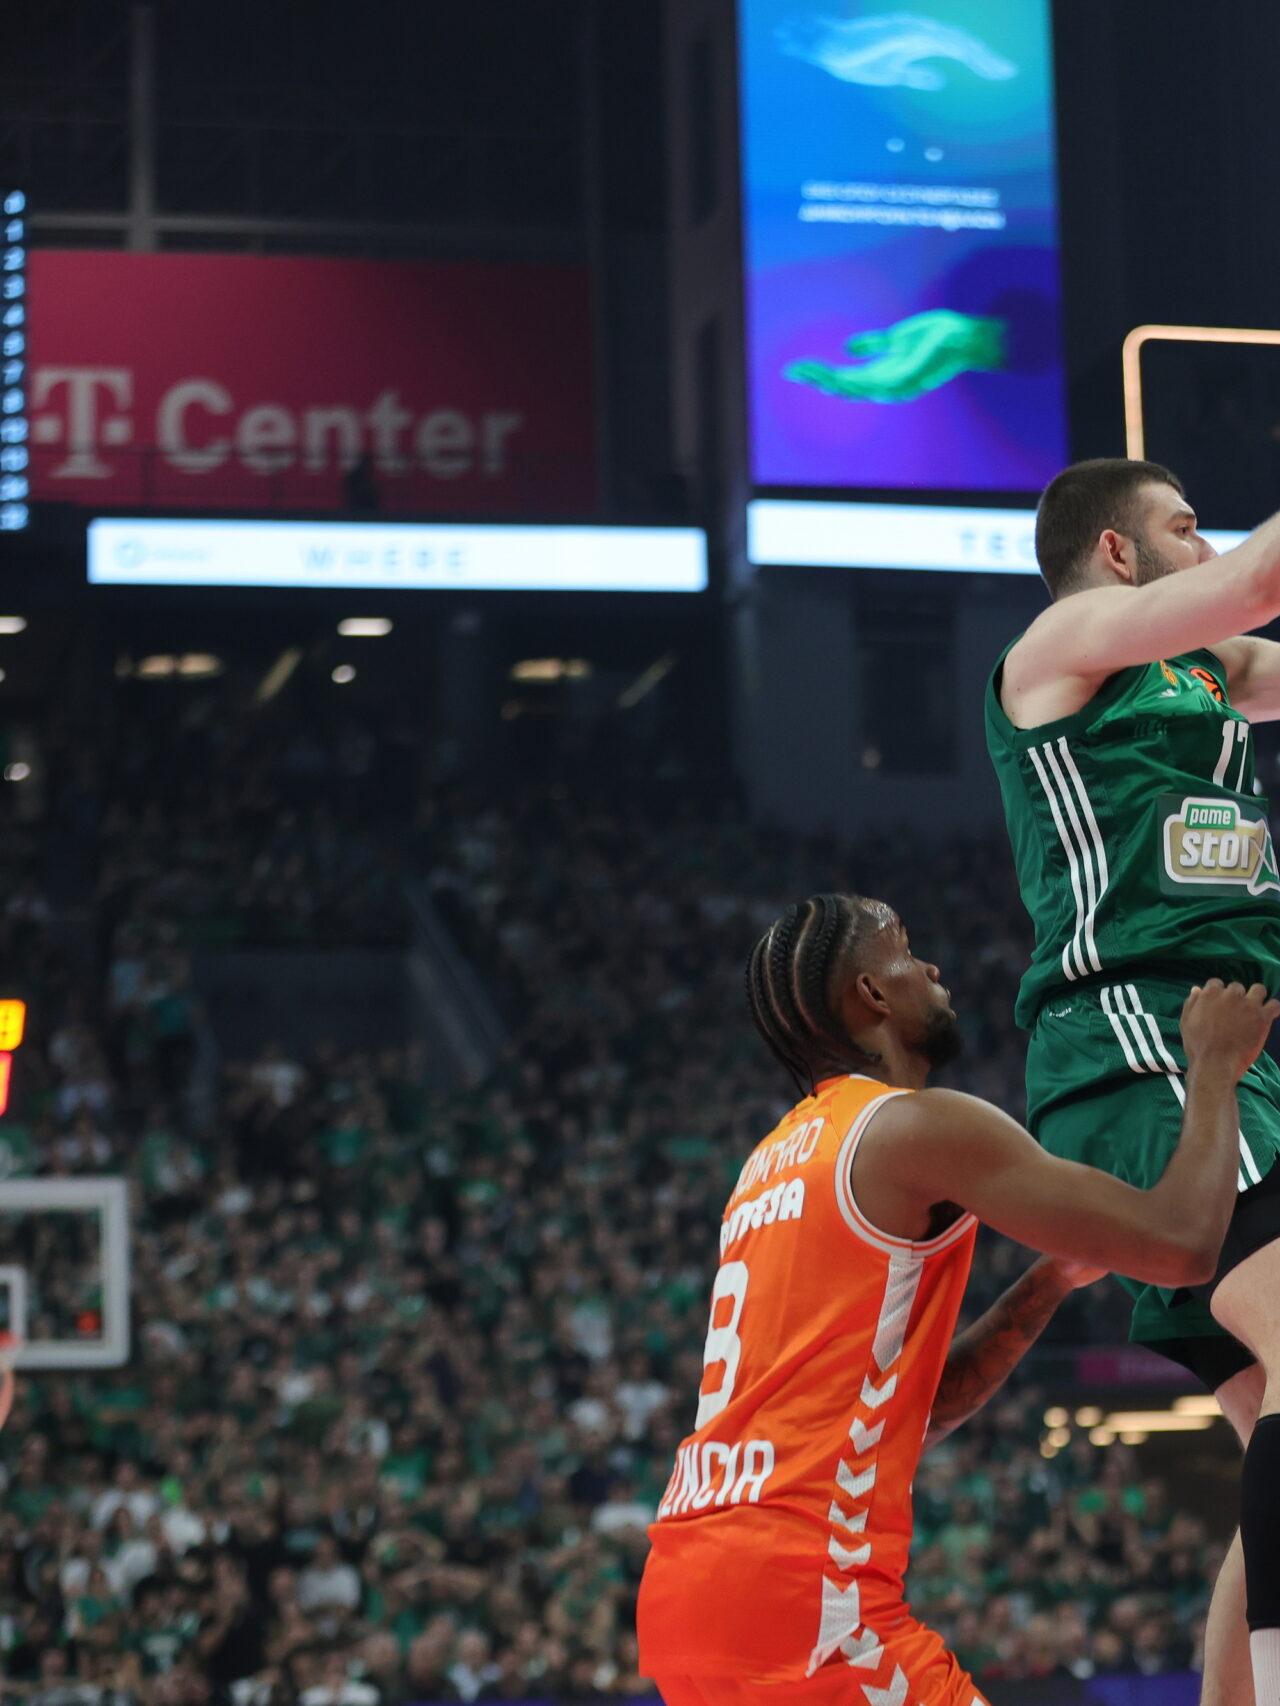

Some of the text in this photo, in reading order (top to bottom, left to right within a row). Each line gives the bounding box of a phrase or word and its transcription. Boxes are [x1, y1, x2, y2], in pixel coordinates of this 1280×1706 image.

[32, 366, 522, 478] T Center
[1213, 719, 1249, 794] 17
[1189, 807, 1232, 826] pame
[695, 1260, 749, 1432] 8
